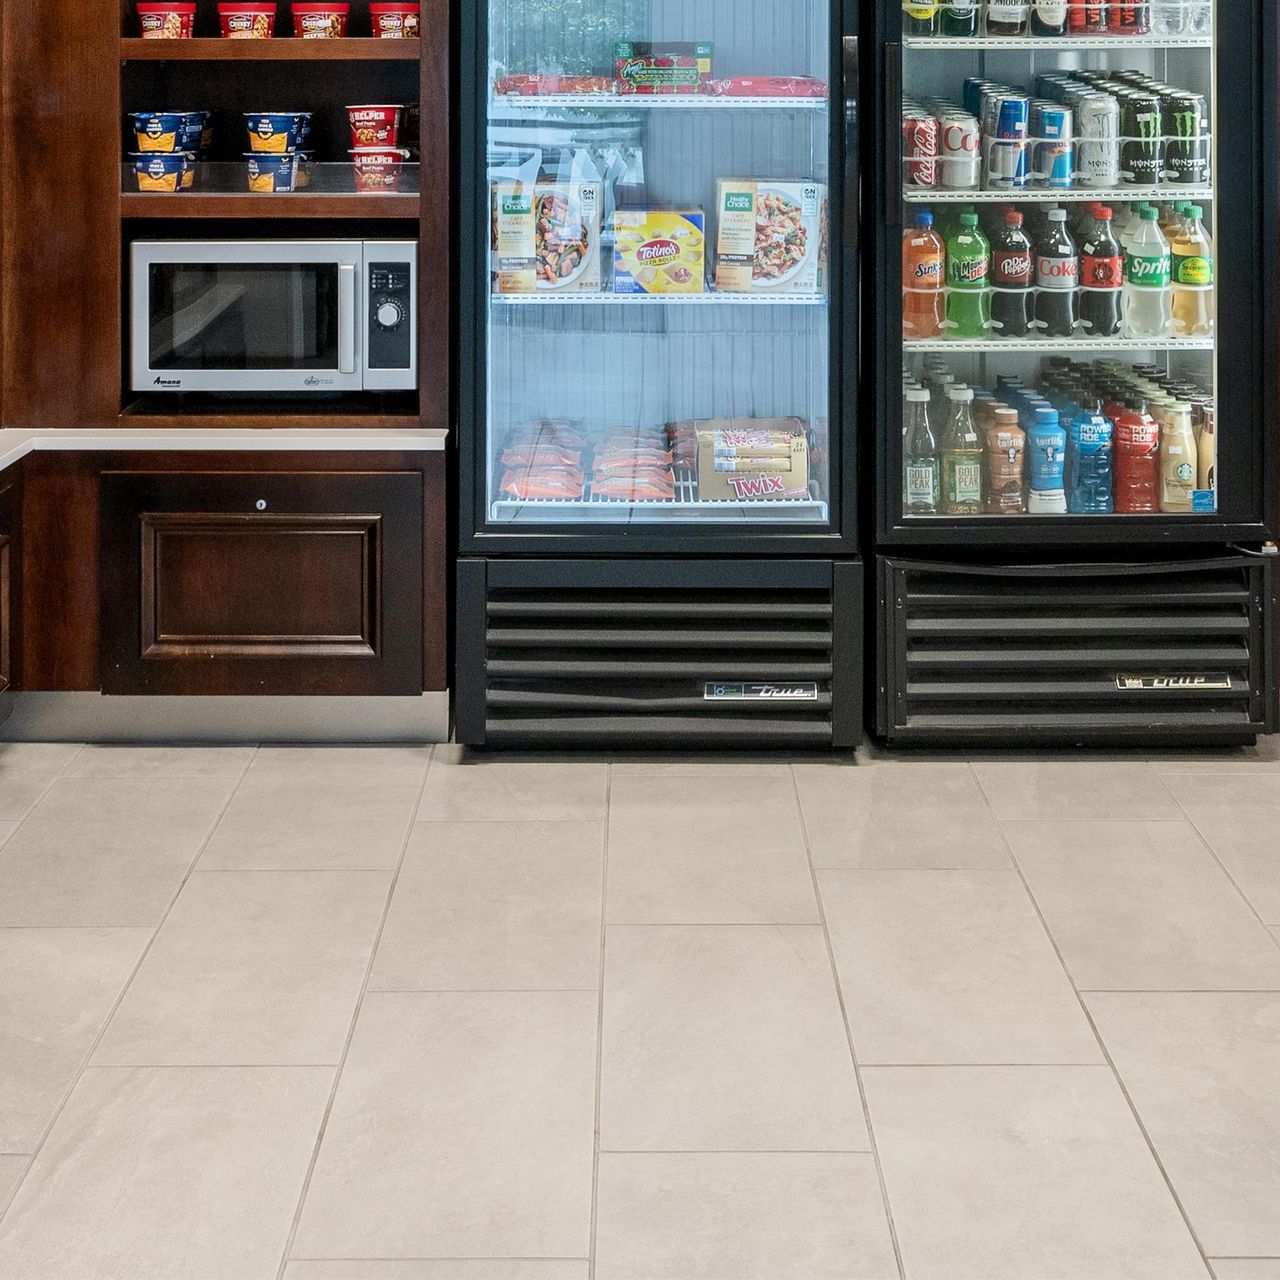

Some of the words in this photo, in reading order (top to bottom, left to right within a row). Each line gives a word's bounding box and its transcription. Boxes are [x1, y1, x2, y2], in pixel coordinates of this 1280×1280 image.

[354, 111, 385, 120] HELPER
[914, 119, 937, 186] Coca-Cola
[361, 156, 393, 164] HELPER
[726, 200, 751, 208] Choice
[640, 245, 677, 260] Totino's
[1039, 260, 1077, 277] Coke
[153, 376, 181, 385] Amana
[1036, 435, 1063, 446] fairlife
[1080, 433, 1099, 441] ADE
[909, 469, 931, 479] GOLD
[959, 467, 979, 477] GOLD
[909, 479, 931, 489] PEAK
[958, 477, 979, 486] PEAK
